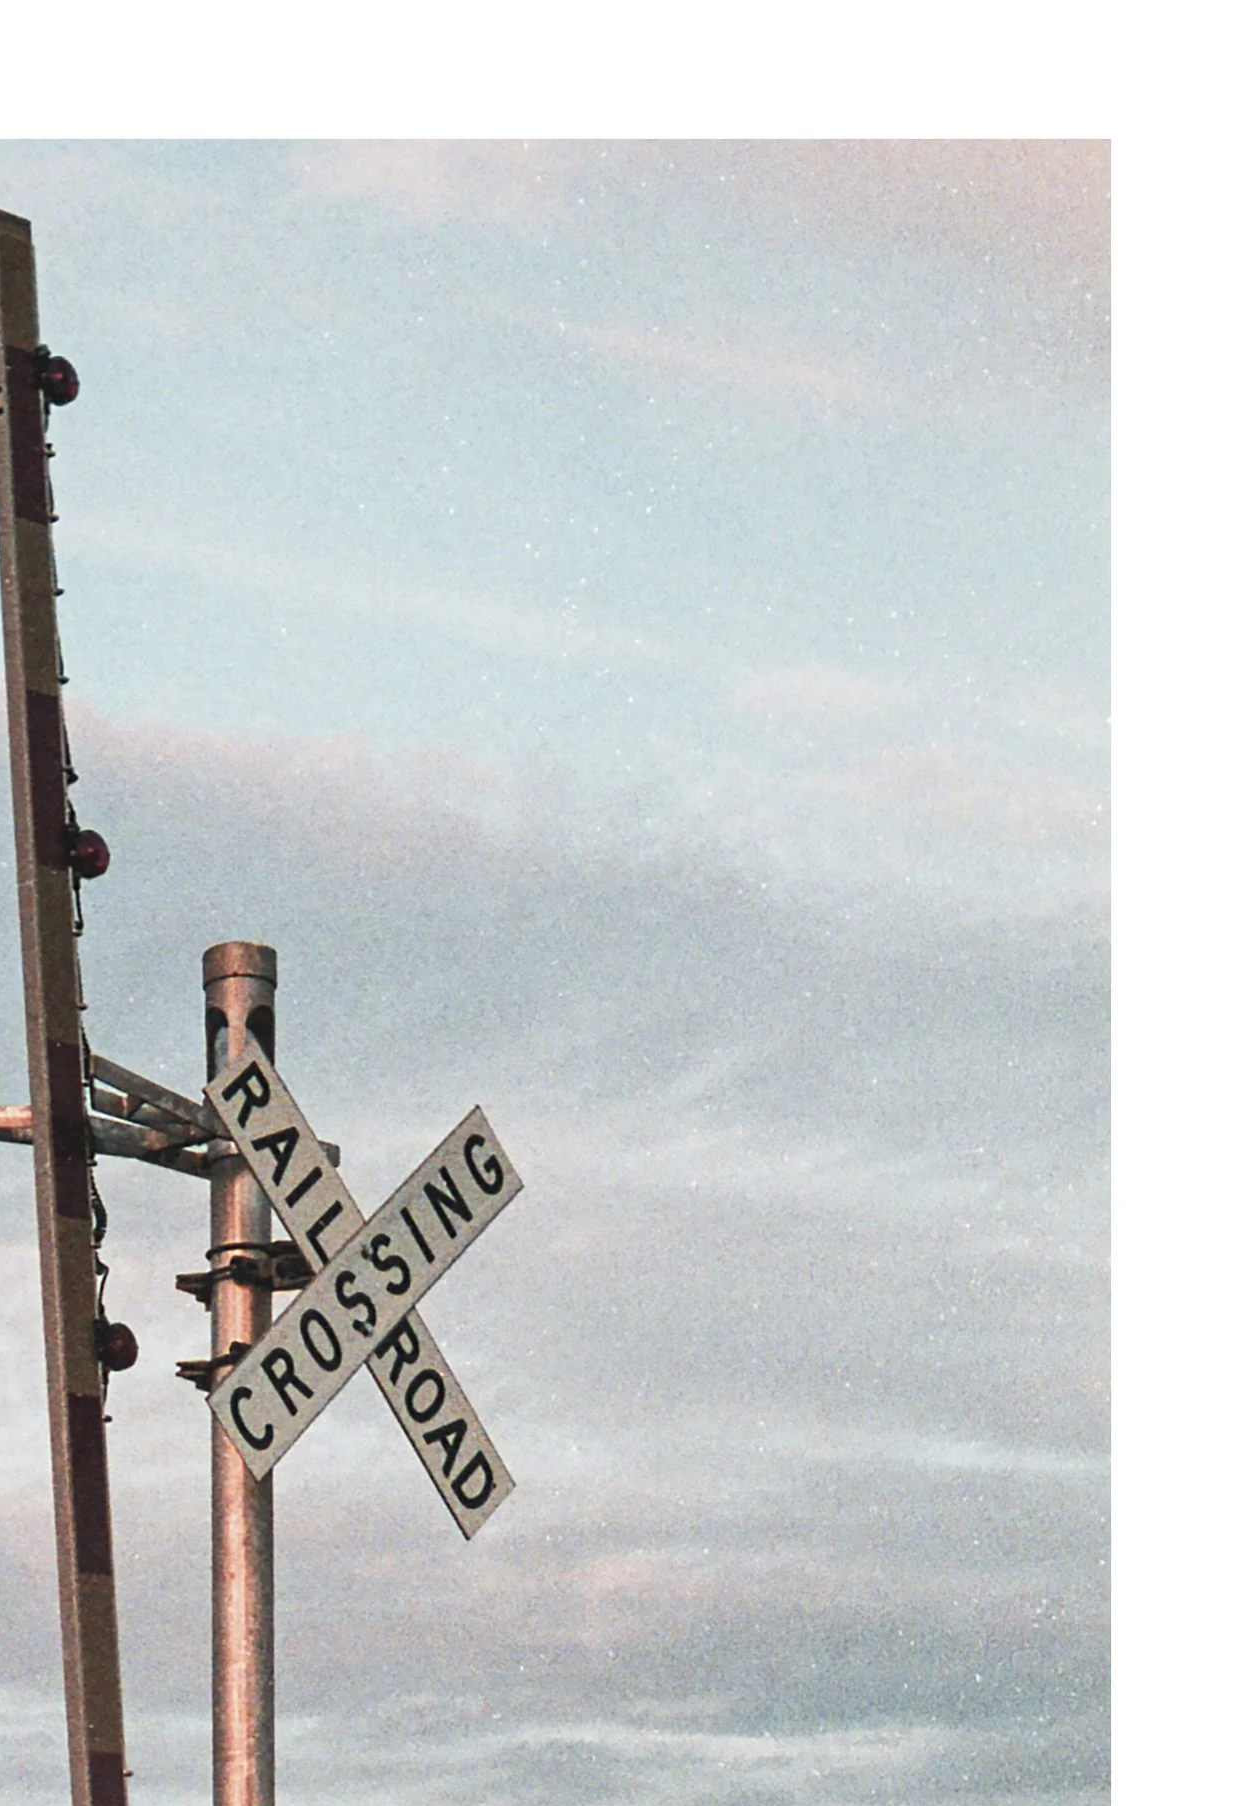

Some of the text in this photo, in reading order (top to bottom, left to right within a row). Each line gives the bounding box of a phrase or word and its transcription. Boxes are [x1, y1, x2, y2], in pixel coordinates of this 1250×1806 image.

[222, 1061, 496, 1510] RAIL ROAD
[229, 1133, 504, 1452] CROSSING
